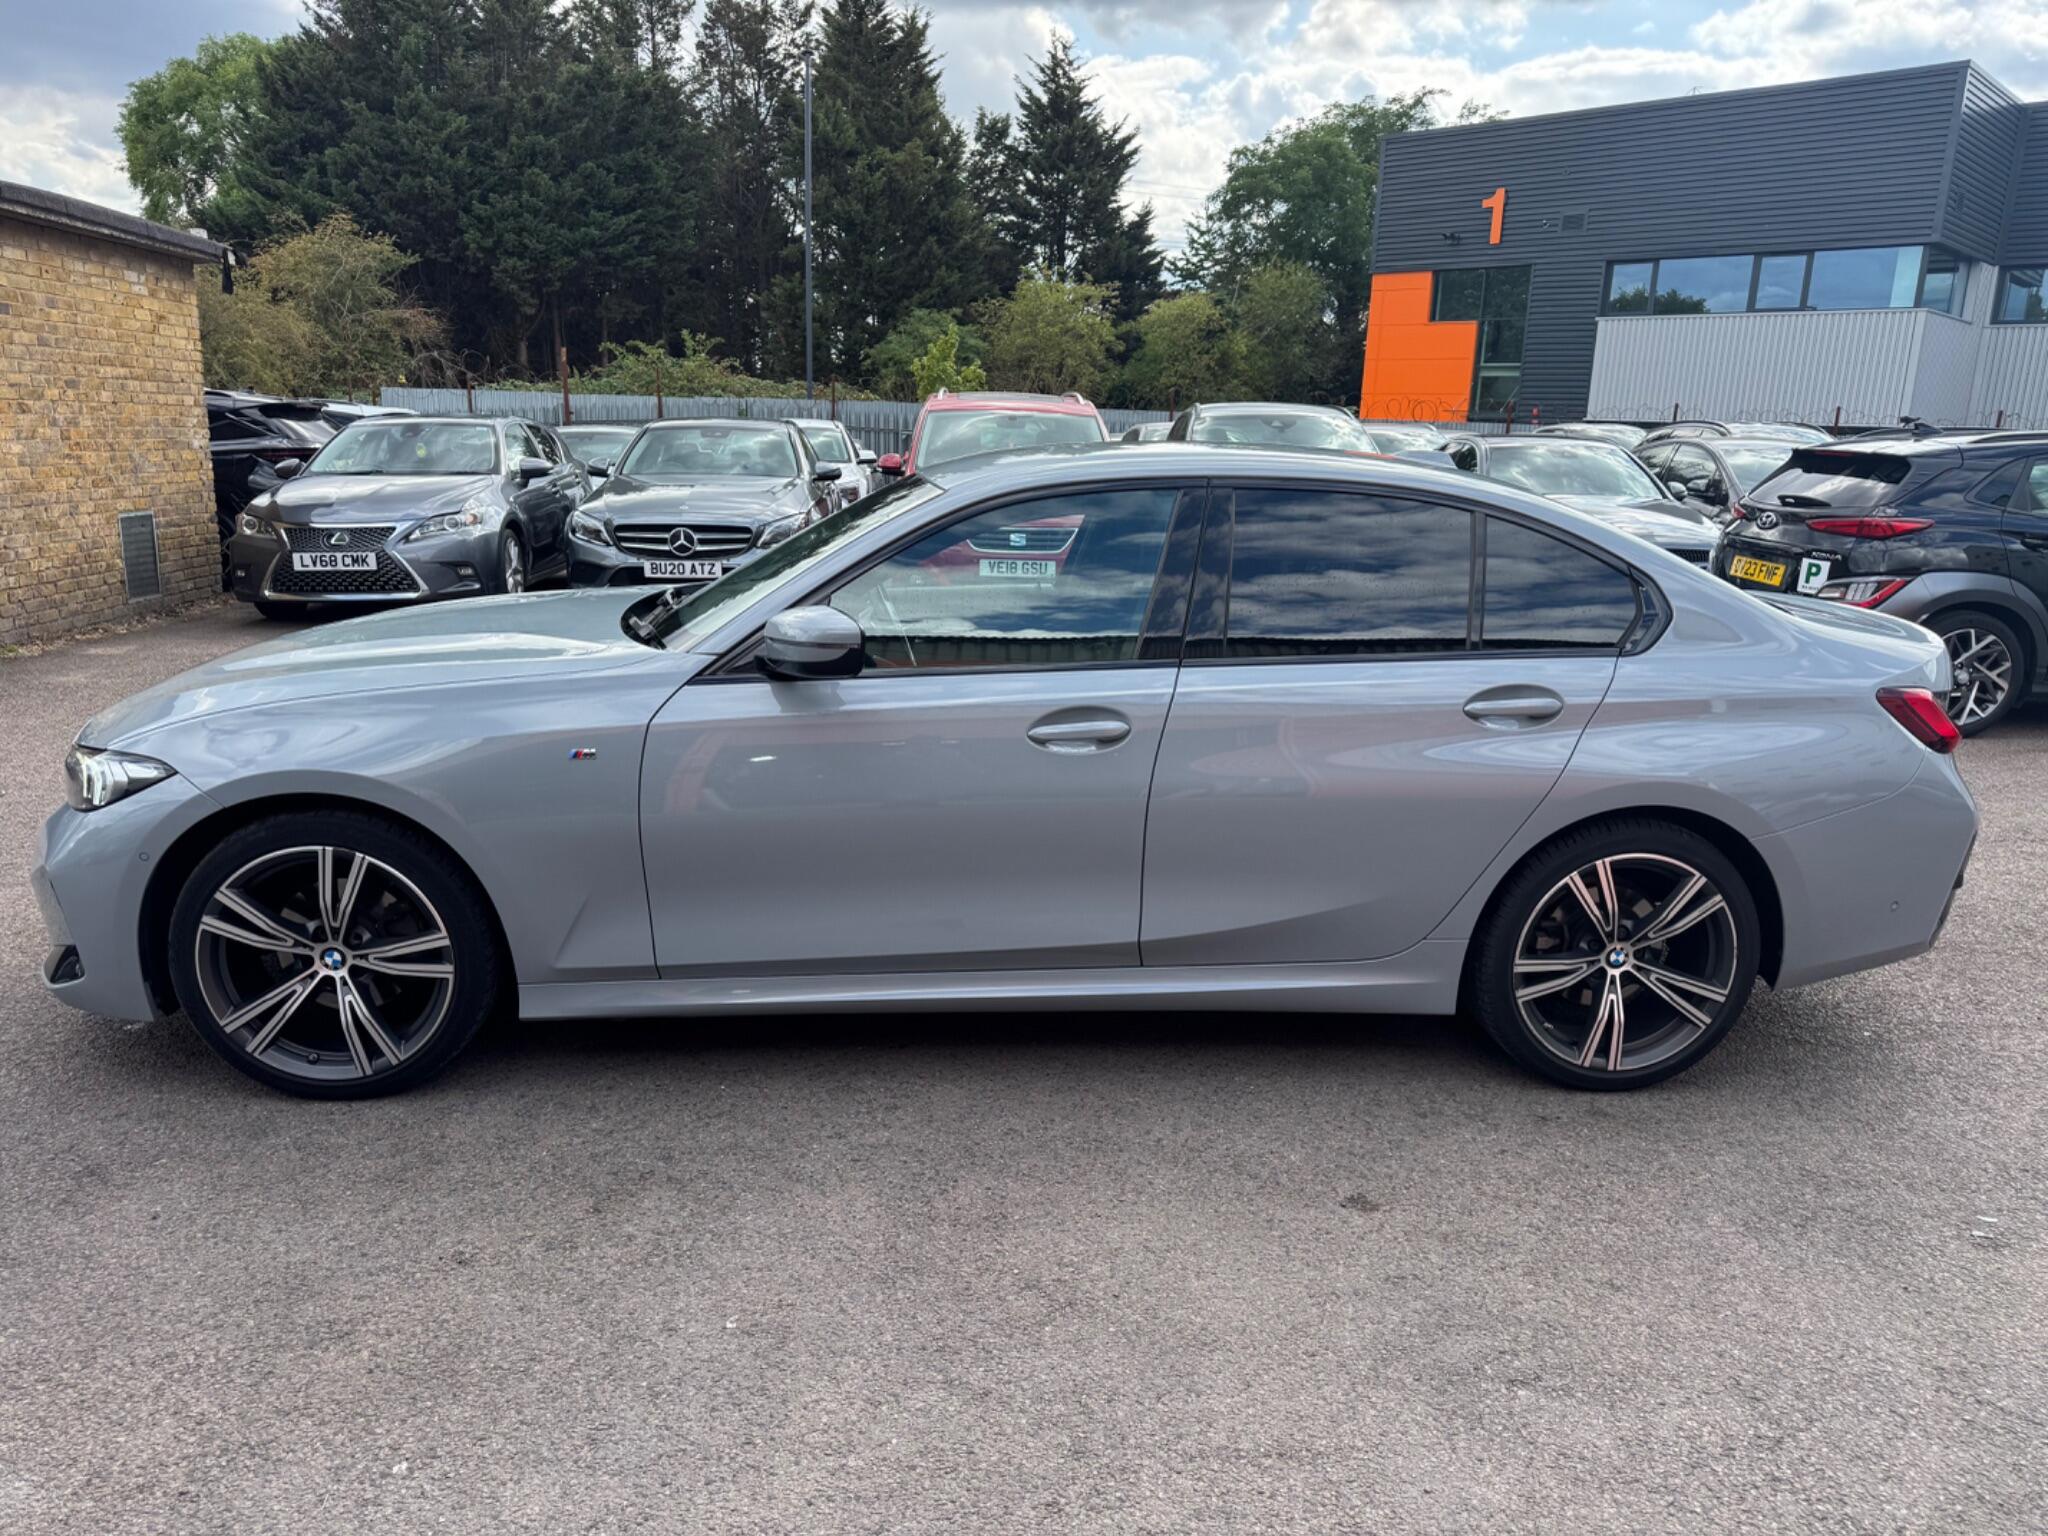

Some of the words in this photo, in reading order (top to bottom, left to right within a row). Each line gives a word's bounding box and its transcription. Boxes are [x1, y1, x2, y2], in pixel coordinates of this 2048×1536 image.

[1482, 187, 1505, 245] 1
[300, 554, 338, 568] LV68
[341, 554, 370, 568] CMK
[988, 561, 1018, 574] VE18
[1021, 561, 1048, 575] GSU
[650, 562, 685, 575] BU20
[689, 562, 716, 575] ATZ
[1805, 561, 1822, 584] P
